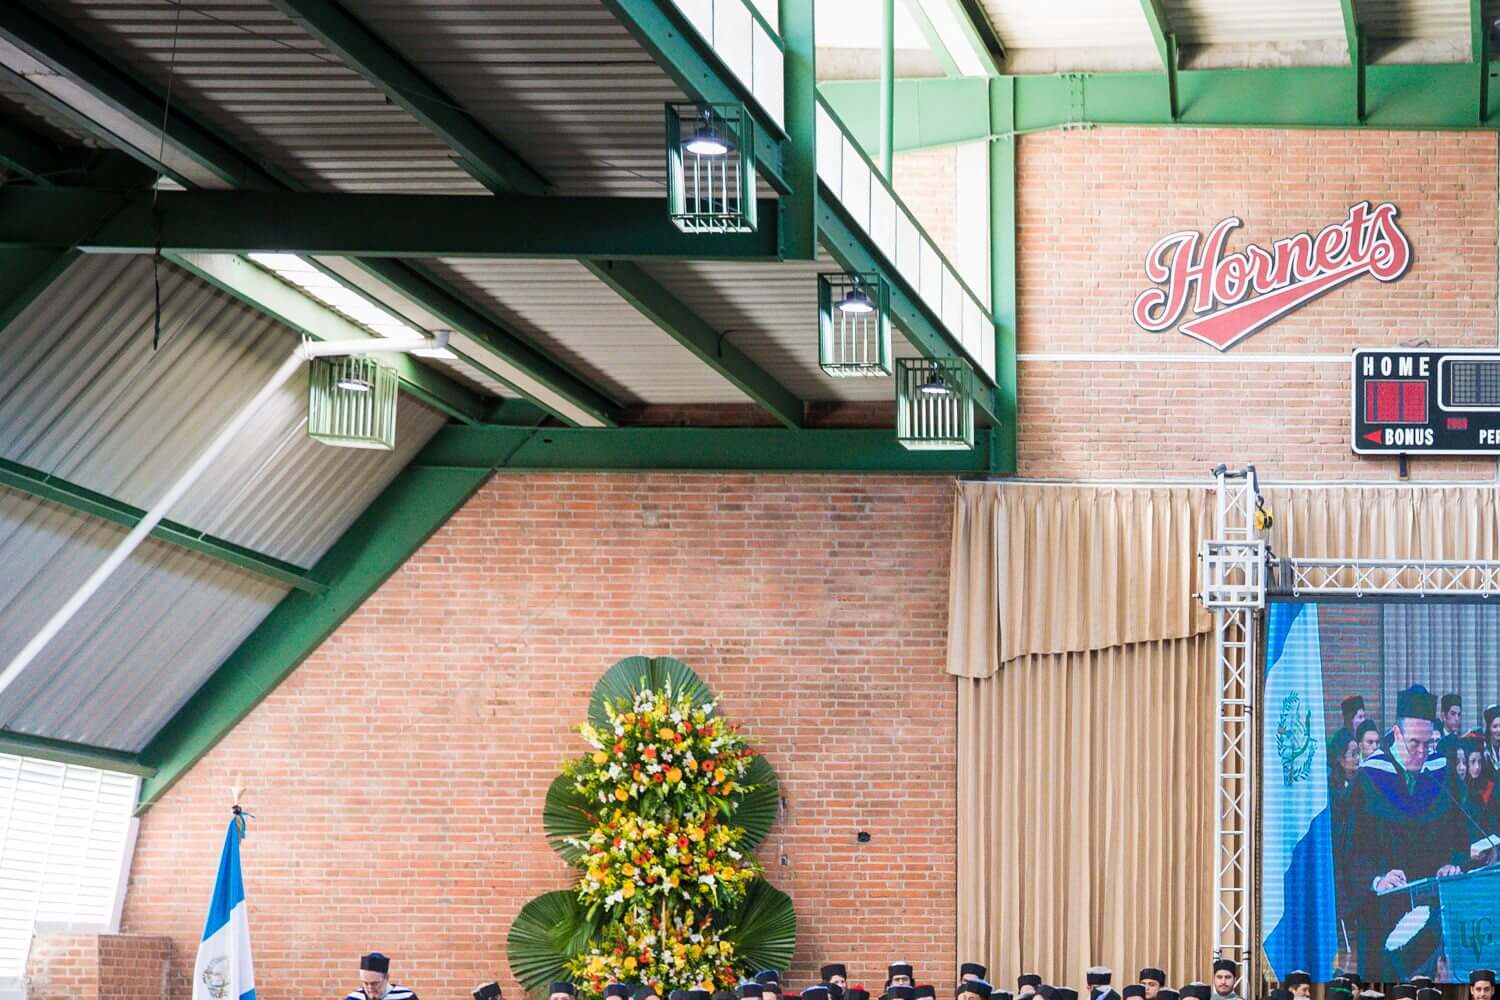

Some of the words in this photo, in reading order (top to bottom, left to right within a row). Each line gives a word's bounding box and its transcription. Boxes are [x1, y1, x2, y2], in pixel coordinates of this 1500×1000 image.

[1133, 201, 1409, 331] Hornets
[1363, 356, 1430, 376] HOME
[1384, 428, 1434, 445] BONUS
